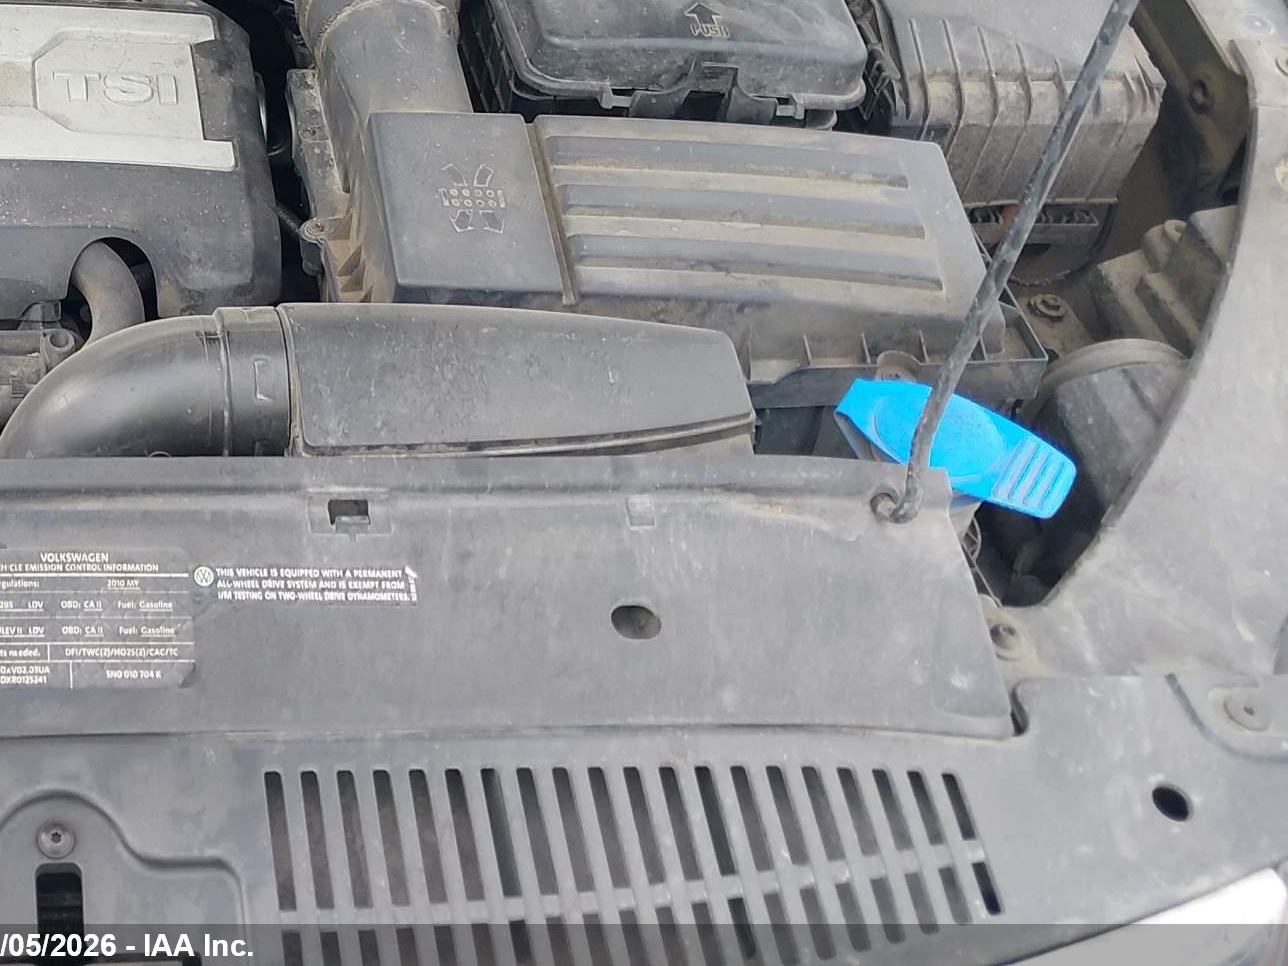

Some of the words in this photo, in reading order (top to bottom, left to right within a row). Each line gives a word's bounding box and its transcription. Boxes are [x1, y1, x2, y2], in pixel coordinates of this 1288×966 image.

[689, 23, 730, 37] PUSH
[52, 70, 178, 107] TSI
[40, 553, 109, 562] VOLKSWAGEN
[25, 564, 62, 572] EMISSION
[65, 564, 100, 572] CONTROL
[103, 564, 159, 572] INFORMATION
[216, 569, 234, 578] THIS
[236, 569, 267, 577] VEHICLE
[270, 569, 278, 577] IS
[280, 569, 320, 578] EQUIPPED
[321, 569, 343, 578] WITH
[345, 569, 352, 578] A
[354, 569, 402, 578] PERMANENT
[217, 580, 259, 588] ALL-WHEEL
[261, 580, 285, 589] DRIVE
[287, 580, 317, 589] SYSTEM
[319, 580, 336, 589] AND
[339, 580, 346, 589] IS
[349, 580, 380, 589] EXEMPT
[382, 581, 404, 589] FROM
[218, 591, 232, 600] I/M
[234, 591, 263, 600] TESTING
[265, 592, 276, 600] ON
[278, 592, 322, 601] TWO-WHEEL
[324, 592, 346, 601] DRIVE
[347, 592, 410, 601] DYNAMOMETERS.
[28, 601, 43, 609] LDV
[61, 601, 80, 609] OBD:
[84, 601, 95, 609] CA
[118, 601, 136, 609] Fuel:
[139, 601, 173, 609] Gasoline
[29, 627, 44, 635] LDV
[61, 627, 82, 635] OBD:
[84, 627, 96, 635] CA
[119, 627, 137, 635] Fuel:
[141, 627, 175, 635] Gasoline
